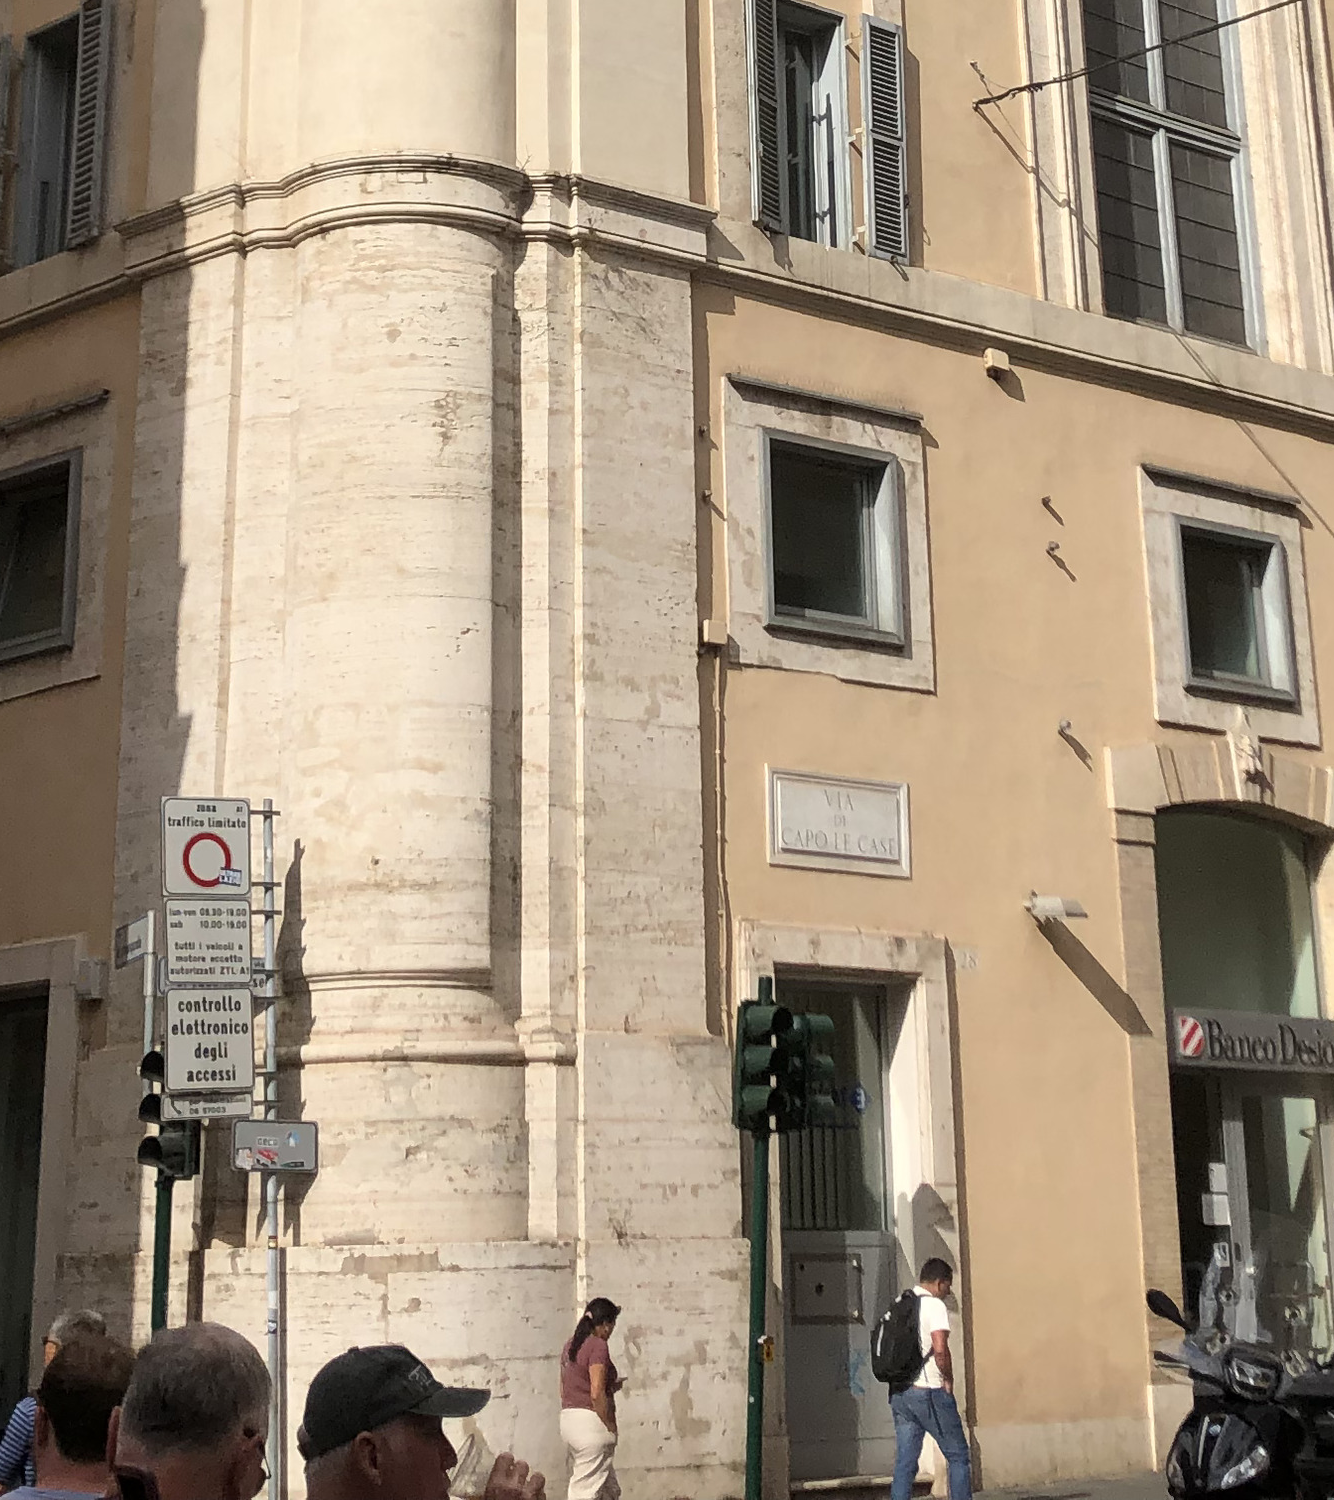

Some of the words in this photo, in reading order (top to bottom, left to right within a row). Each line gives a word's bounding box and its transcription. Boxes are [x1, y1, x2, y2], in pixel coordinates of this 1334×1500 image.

[823, 788, 854, 811] VIA
[196, 804, 217, 813] zona
[167, 816, 205, 828] traffico
[207, 817, 247, 828] limitato
[833, 814, 846, 827] DI
[781, 827, 828, 849] CAPO
[834, 832, 850, 852] LE
[857, 835, 895, 856] CASE
[174, 941, 195, 950] tutti
[206, 942, 234, 950] veicoli
[175, 954, 206, 963] motore
[210, 954, 243, 963] eccetto
[170, 966, 215, 975] autorizzati
[220, 966, 237, 975] ZTL
[177, 995, 241, 1013] controllo
[171, 1018, 249, 1035] elettronico
[1205, 1016, 1276, 1064] Banco
[194, 1041, 228, 1061] degli
[186, 1064, 236, 1082] accessi
